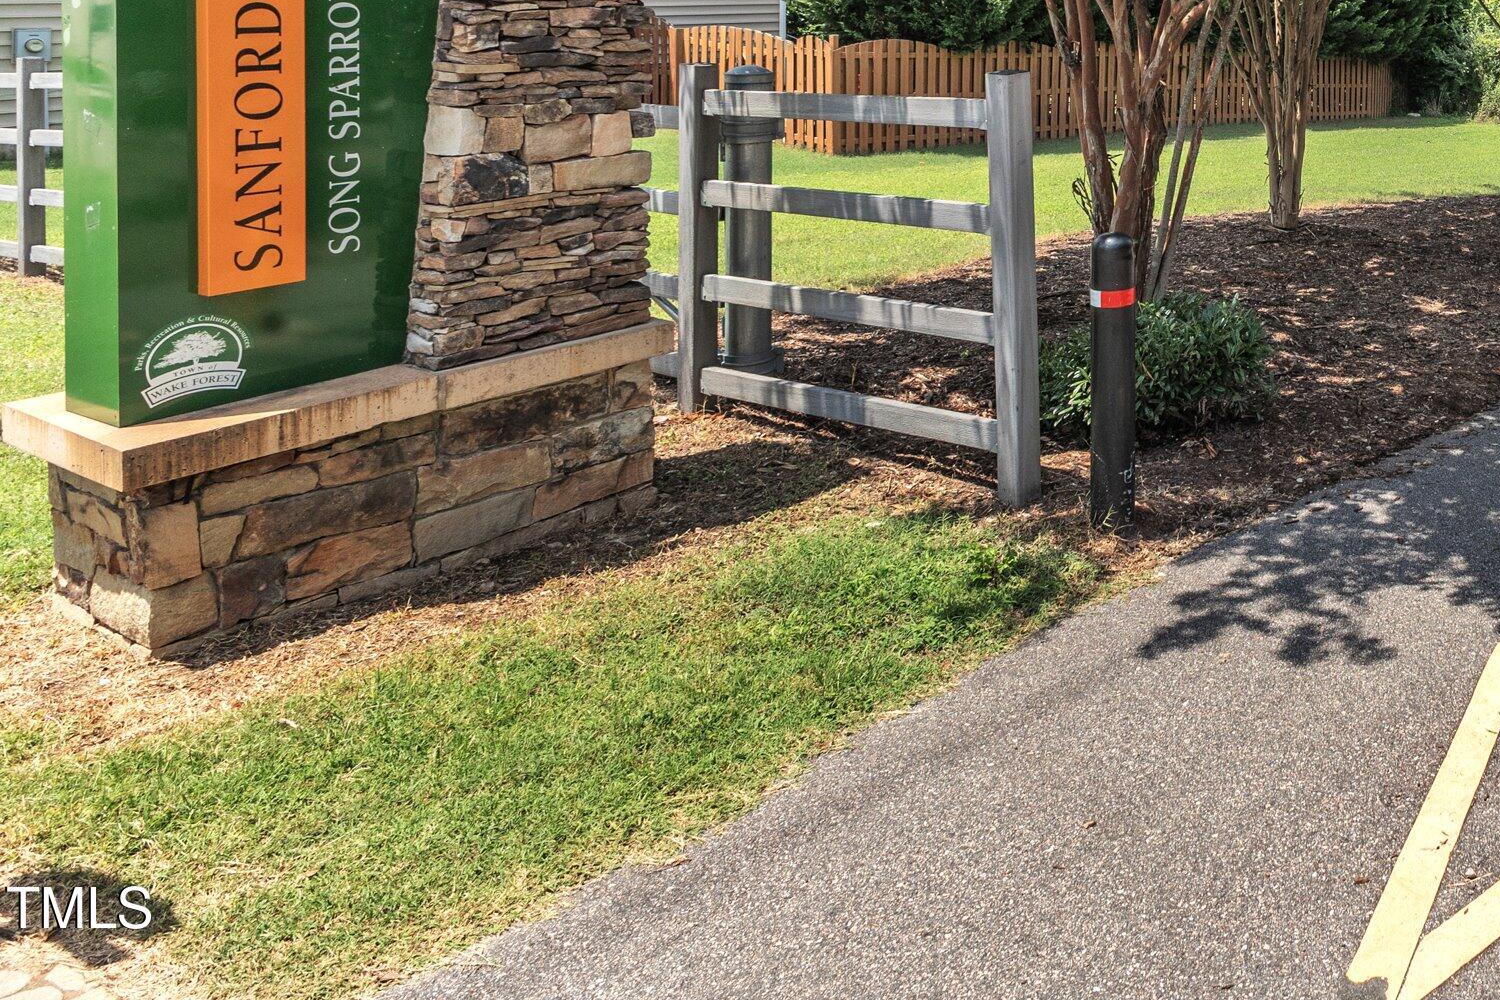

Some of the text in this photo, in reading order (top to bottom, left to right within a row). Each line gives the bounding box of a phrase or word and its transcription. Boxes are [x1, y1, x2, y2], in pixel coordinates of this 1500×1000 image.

[234, 2, 283, 271] SANFORD
[328, 152, 361, 254] SONG
[144, 321, 185, 349] Recreation
[198, 315, 232, 325] Cultural
[230, 321, 250, 349] Resources
[150, 374, 238, 399] WAKE FOREST
[173, 363, 217, 377] TOWN of
